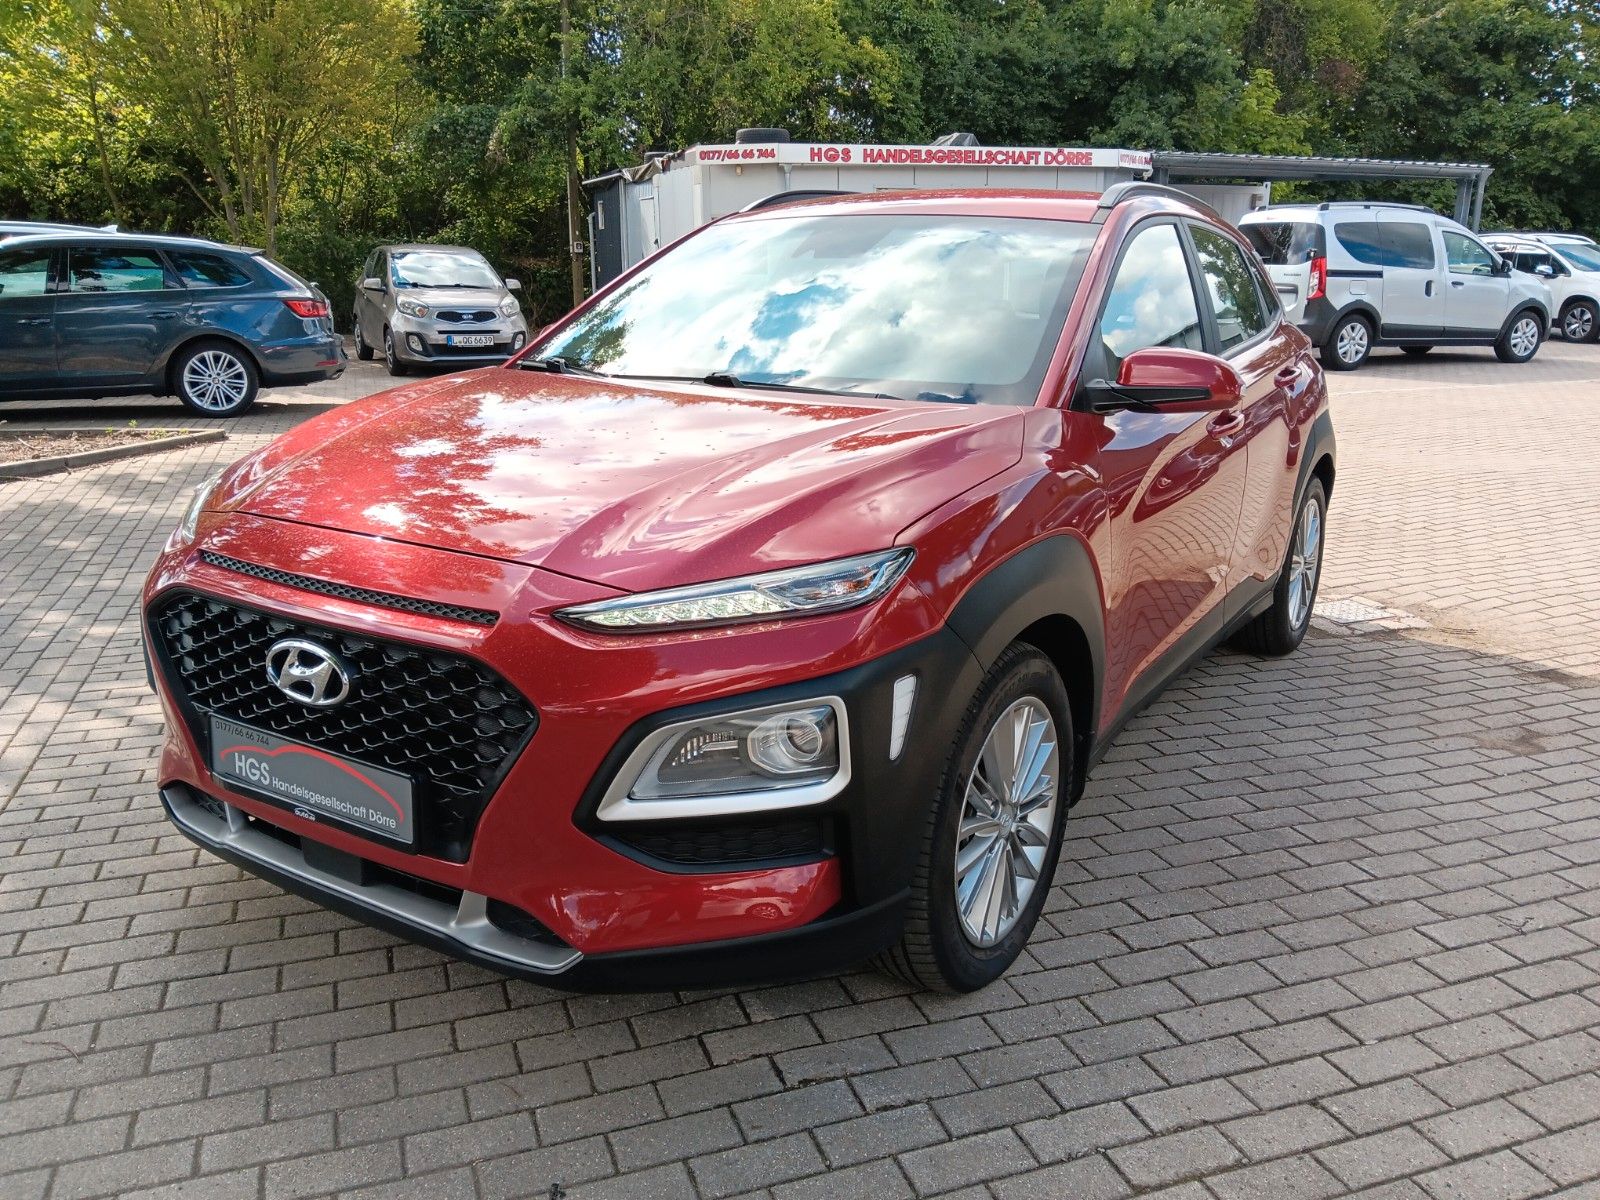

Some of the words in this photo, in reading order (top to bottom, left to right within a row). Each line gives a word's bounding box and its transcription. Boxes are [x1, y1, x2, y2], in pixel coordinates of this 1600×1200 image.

[699, 149, 740, 161] 0177/66
[741, 149, 755, 160] 66
[757, 148, 776, 159] 744
[810, 147, 851, 163] HGS
[863, 149, 1041, 166] HANDELSGESELLSCHAFT
[1044, 147, 1093, 166] DÖRRE
[452, 336, 458, 344] L
[474, 336, 493, 344] 6639
[215, 719, 244, 738] 0177/66
[244, 728, 255, 741] 66
[256, 732, 270, 746] 744
[234, 752, 271, 786] HGS
[272, 776, 367, 818] Handelsgesellschaft
[369, 808, 397, 829] Dörre
